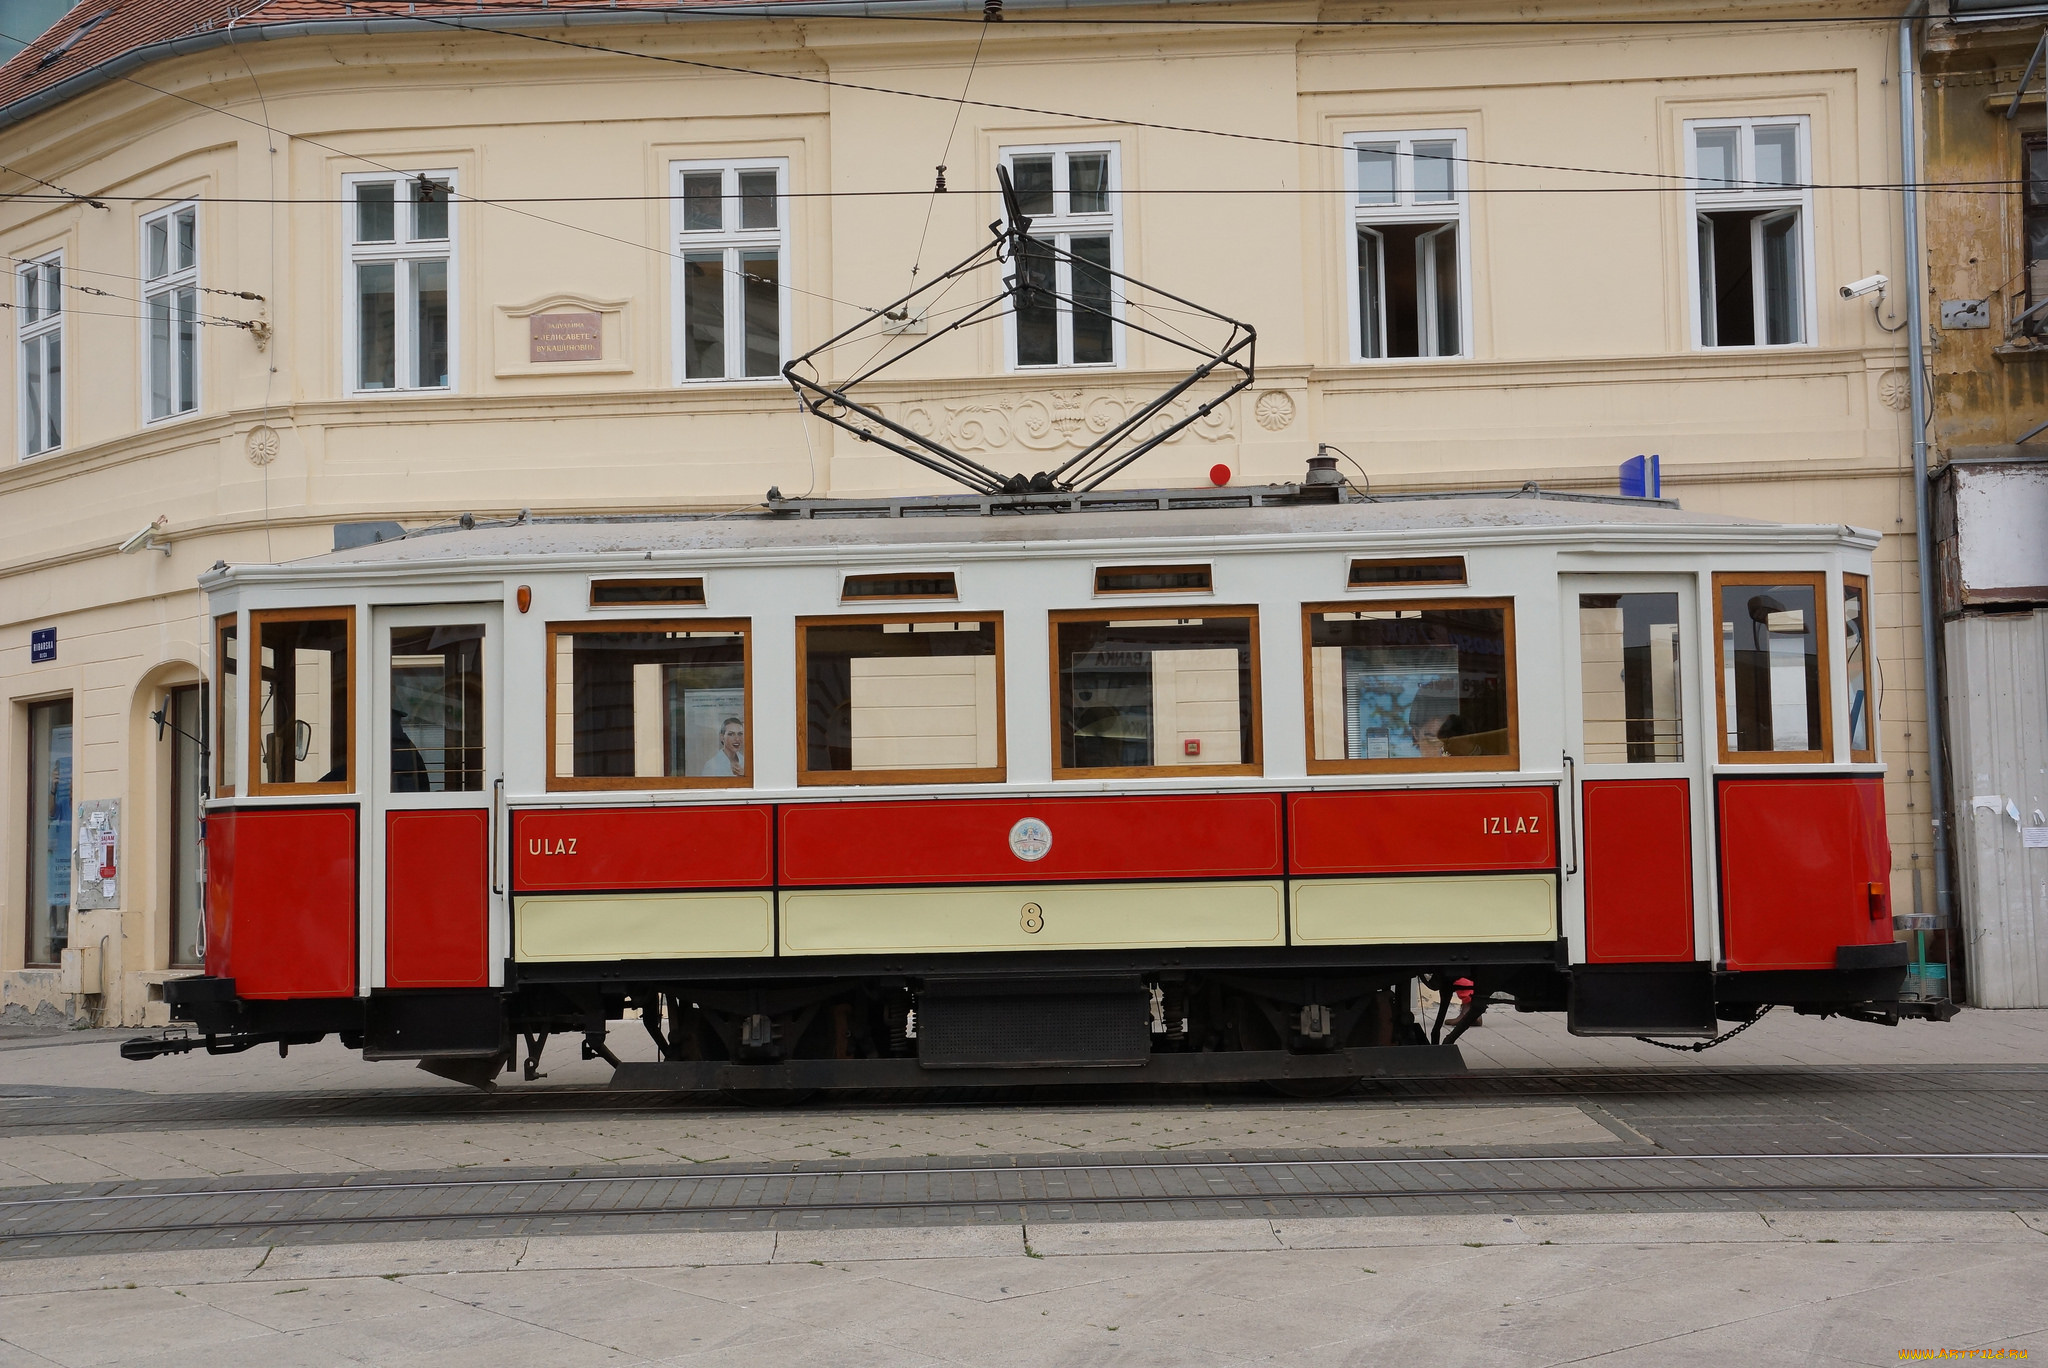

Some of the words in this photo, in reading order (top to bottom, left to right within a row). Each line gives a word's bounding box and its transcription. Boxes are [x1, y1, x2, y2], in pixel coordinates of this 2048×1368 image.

[33, 641, 54, 652] RIBARSKA
[1483, 816, 1540, 834] IZLAZ
[529, 838, 577, 856] ULAZ
[1020, 902, 1044, 934] 8
